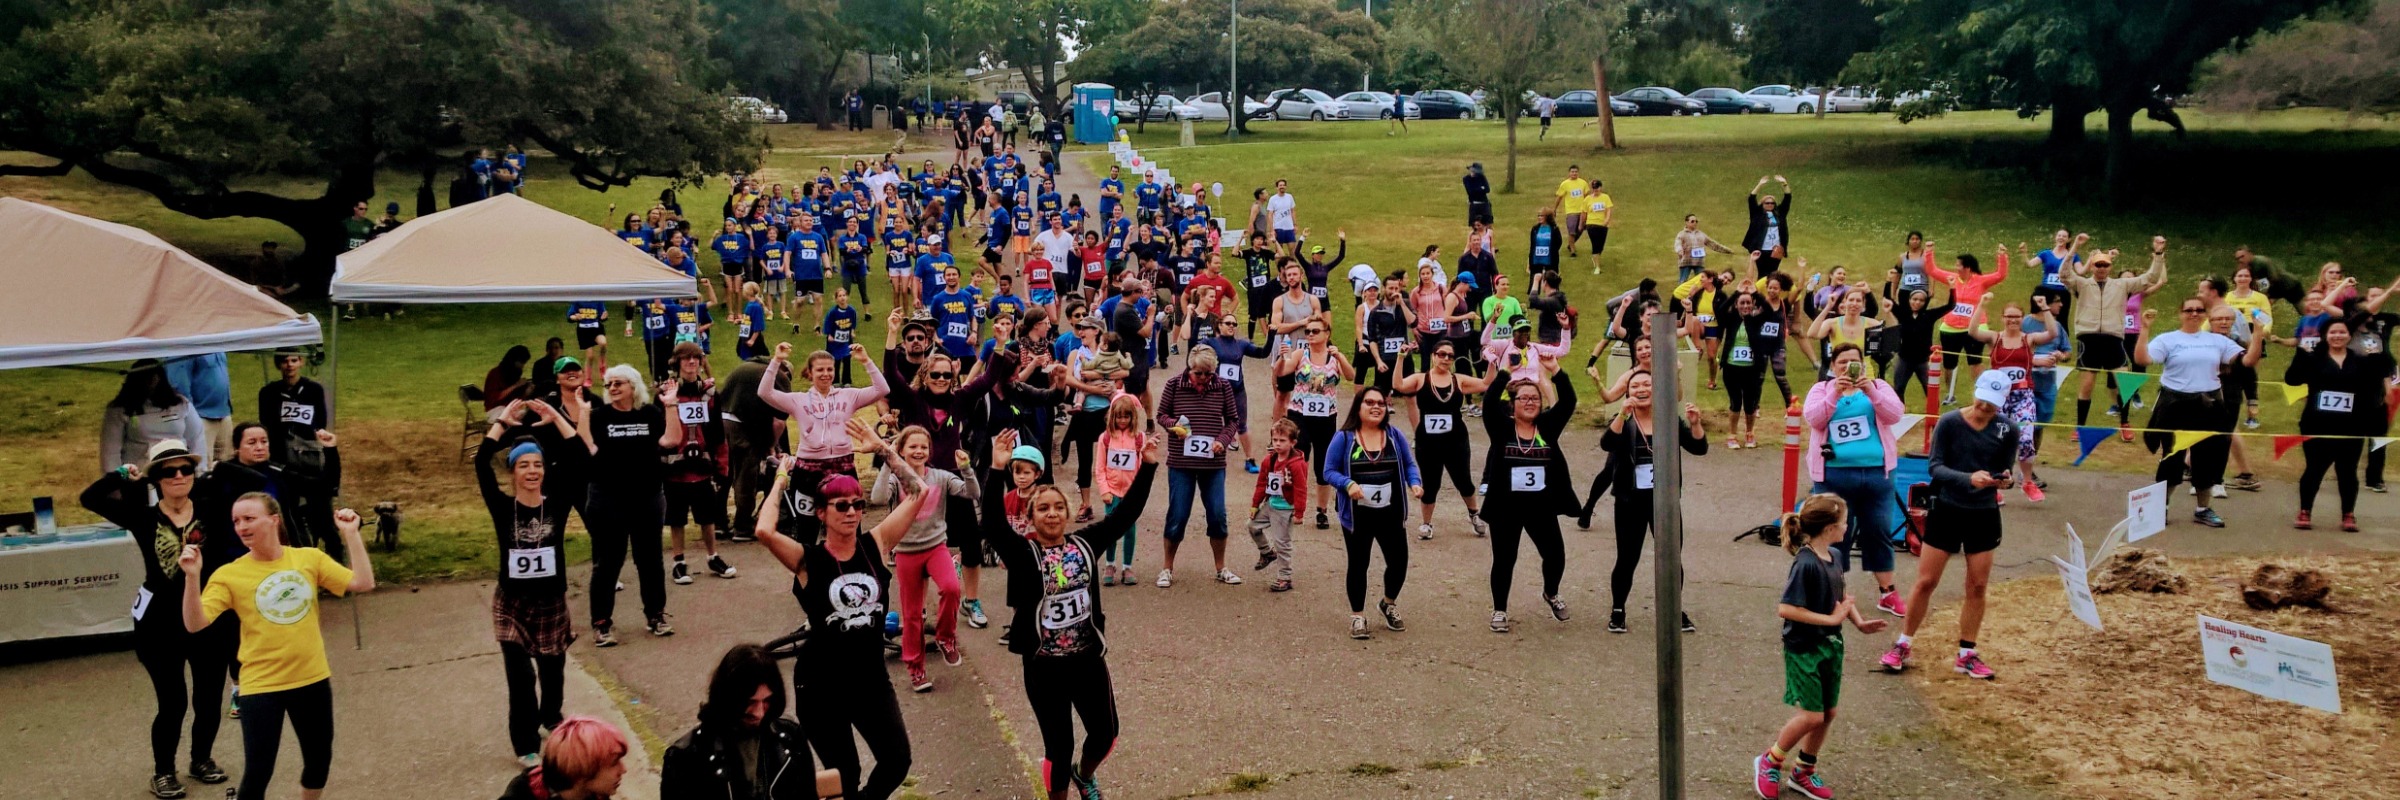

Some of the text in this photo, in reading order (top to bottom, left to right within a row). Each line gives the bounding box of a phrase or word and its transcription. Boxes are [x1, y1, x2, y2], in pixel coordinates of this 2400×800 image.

[1255, 277, 1265, 285] 86
[1313, 288, 1326, 296] 215
[943, 301, 965, 310] TEAM
[948, 306, 966, 314] TOBY
[1955, 305, 1972, 315] 206
[949, 325, 966, 335] 214
[1430, 321, 1446, 329] 252
[1735, 349, 1753, 360] 191
[1227, 367, 1234, 377] 6
[2008, 370, 2025, 381] 60
[1308, 402, 1325, 413] 82
[2322, 395, 2351, 408] 171
[283, 406, 311, 420] 256
[686, 406, 703, 419] 28
[1430, 418, 1448, 430] 72
[1837, 422, 1862, 438] 83
[1190, 440, 1210, 454] 52
[1112, 453, 1131, 467] 47
[1525, 471, 1536, 487] 3
[1371, 490, 1382, 504] 4
[798, 499, 815, 512] 67
[517, 555, 546, 573] 91
[23, 579, 69, 589] SUPPORT
[74, 573, 120, 585] SERVICES
[1049, 598, 1081, 623] 31
[2204, 622, 2238, 639] Healing
[2239, 629, 2267, 643] Hearts
